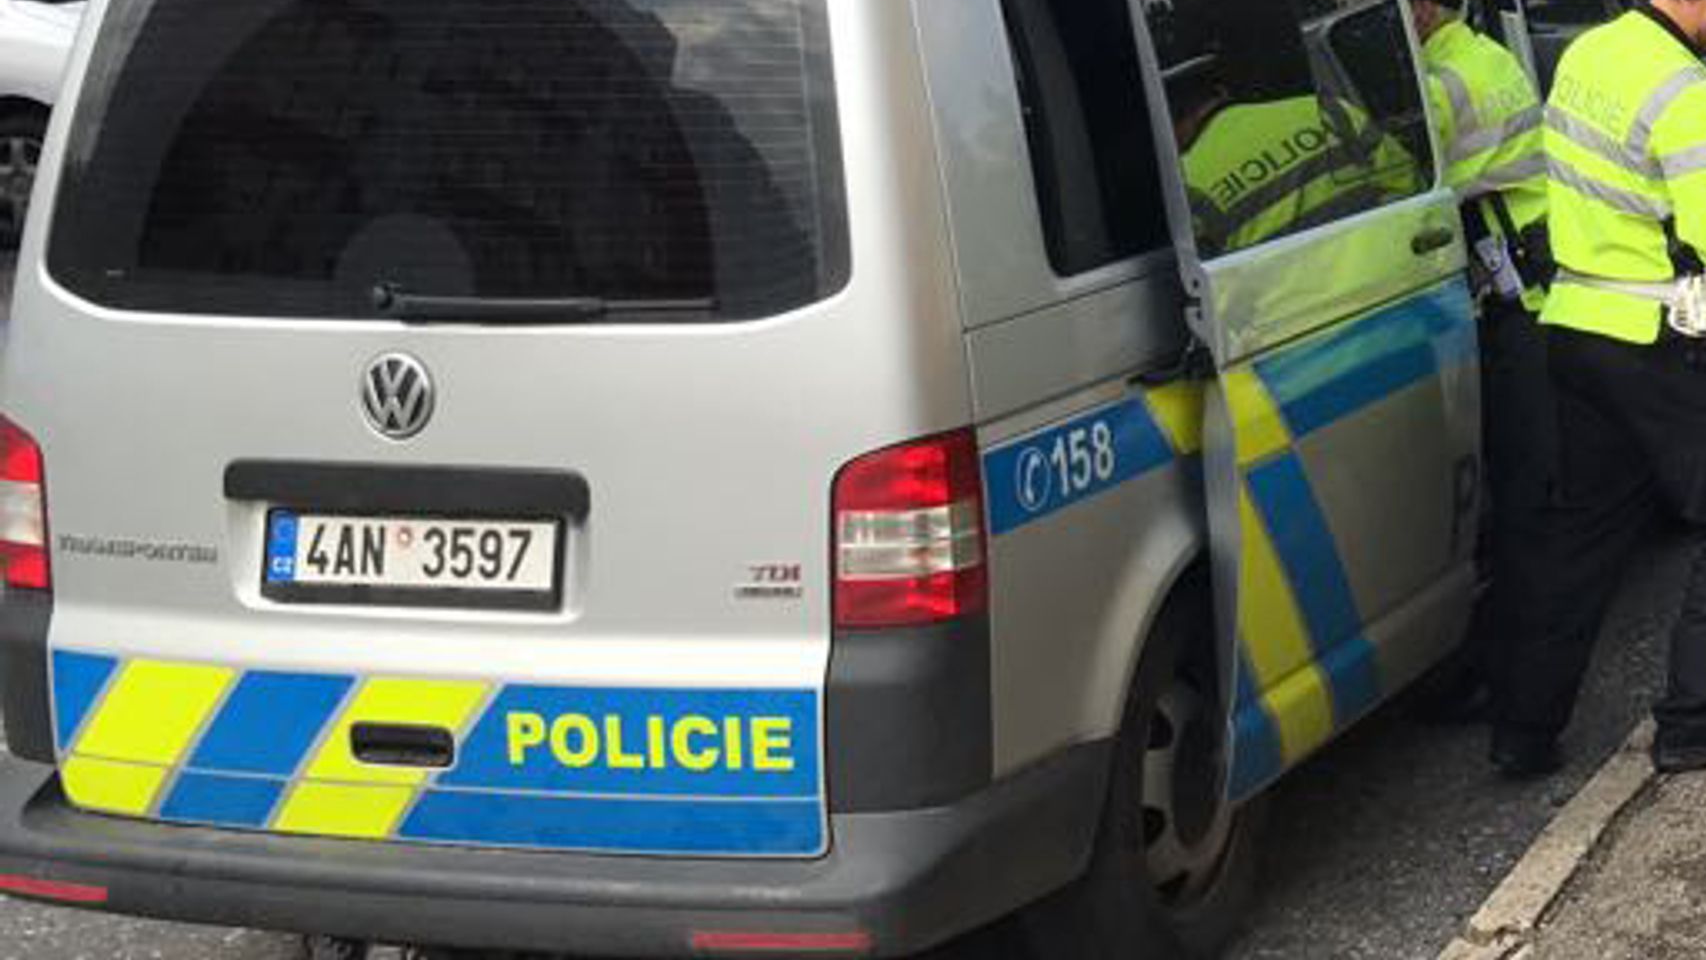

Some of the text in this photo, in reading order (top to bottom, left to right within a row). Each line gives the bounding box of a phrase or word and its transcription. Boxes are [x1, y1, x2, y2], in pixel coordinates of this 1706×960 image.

[1051, 419, 1116, 498] 158
[306, 523, 534, 581] 4AN 3597
[506, 711, 796, 773] POLICIE
